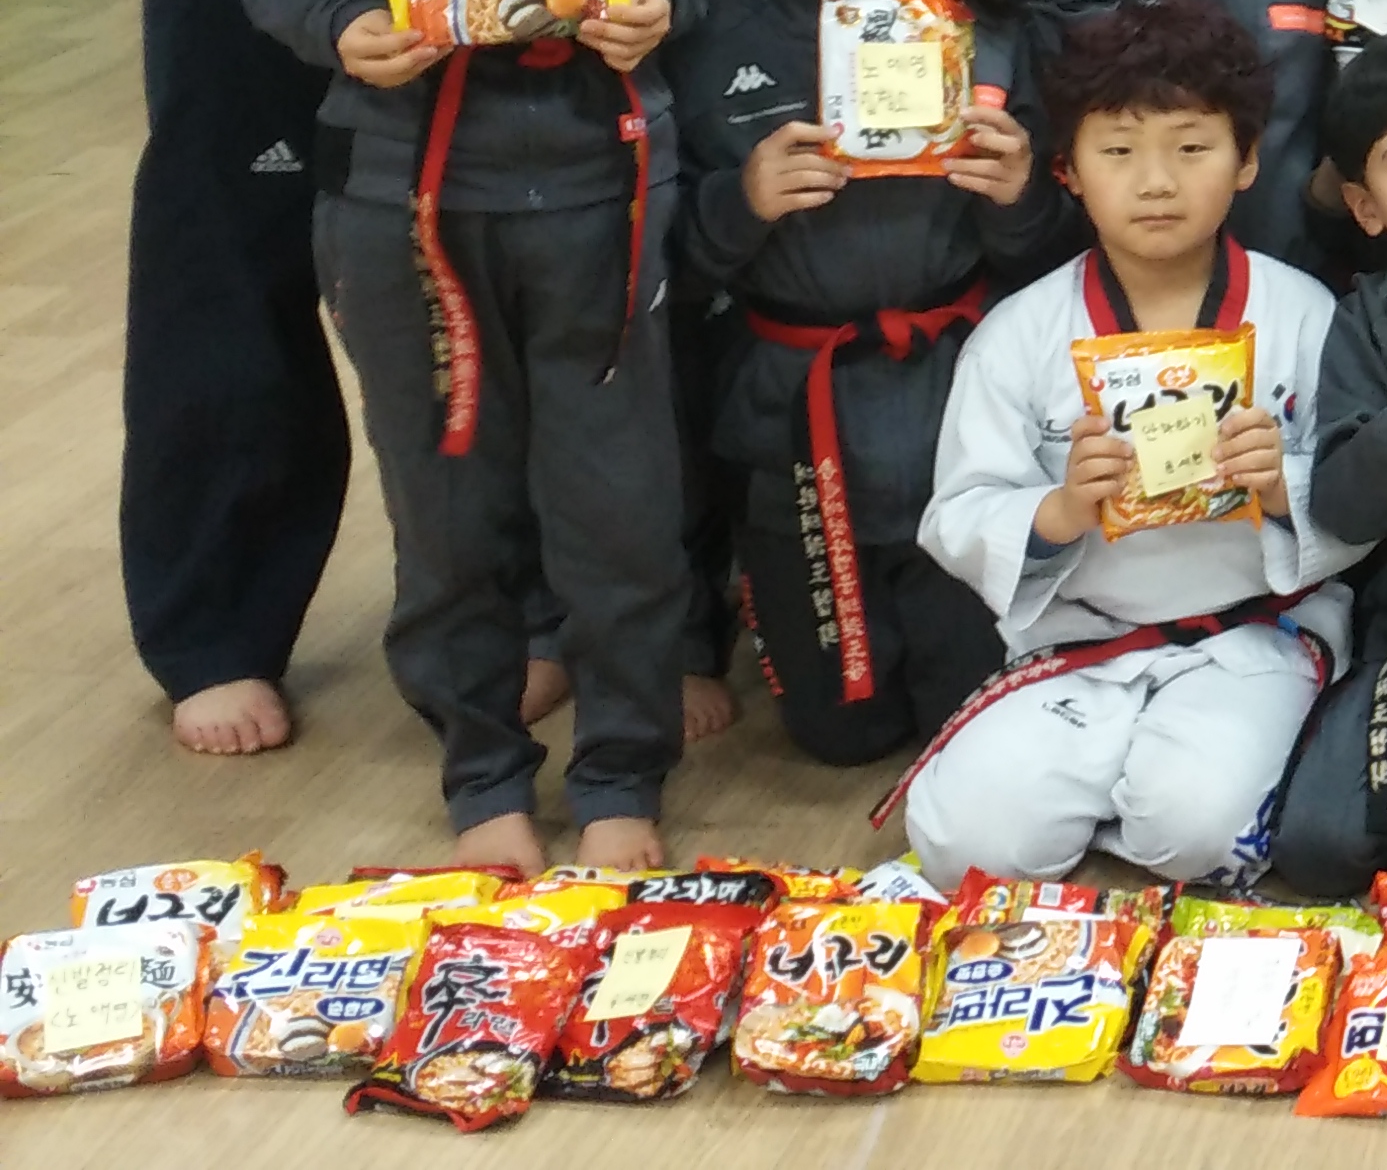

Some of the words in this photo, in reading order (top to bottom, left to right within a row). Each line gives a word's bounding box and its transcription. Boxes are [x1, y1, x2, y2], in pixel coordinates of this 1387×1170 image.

[1107, 372, 1141, 389] 농심
[97, 884, 242, 928] 너구리
[231, 947, 393, 997] 진라면
[768, 934, 910, 985] 너구리
[948, 975, 1098, 1034] 진라면
